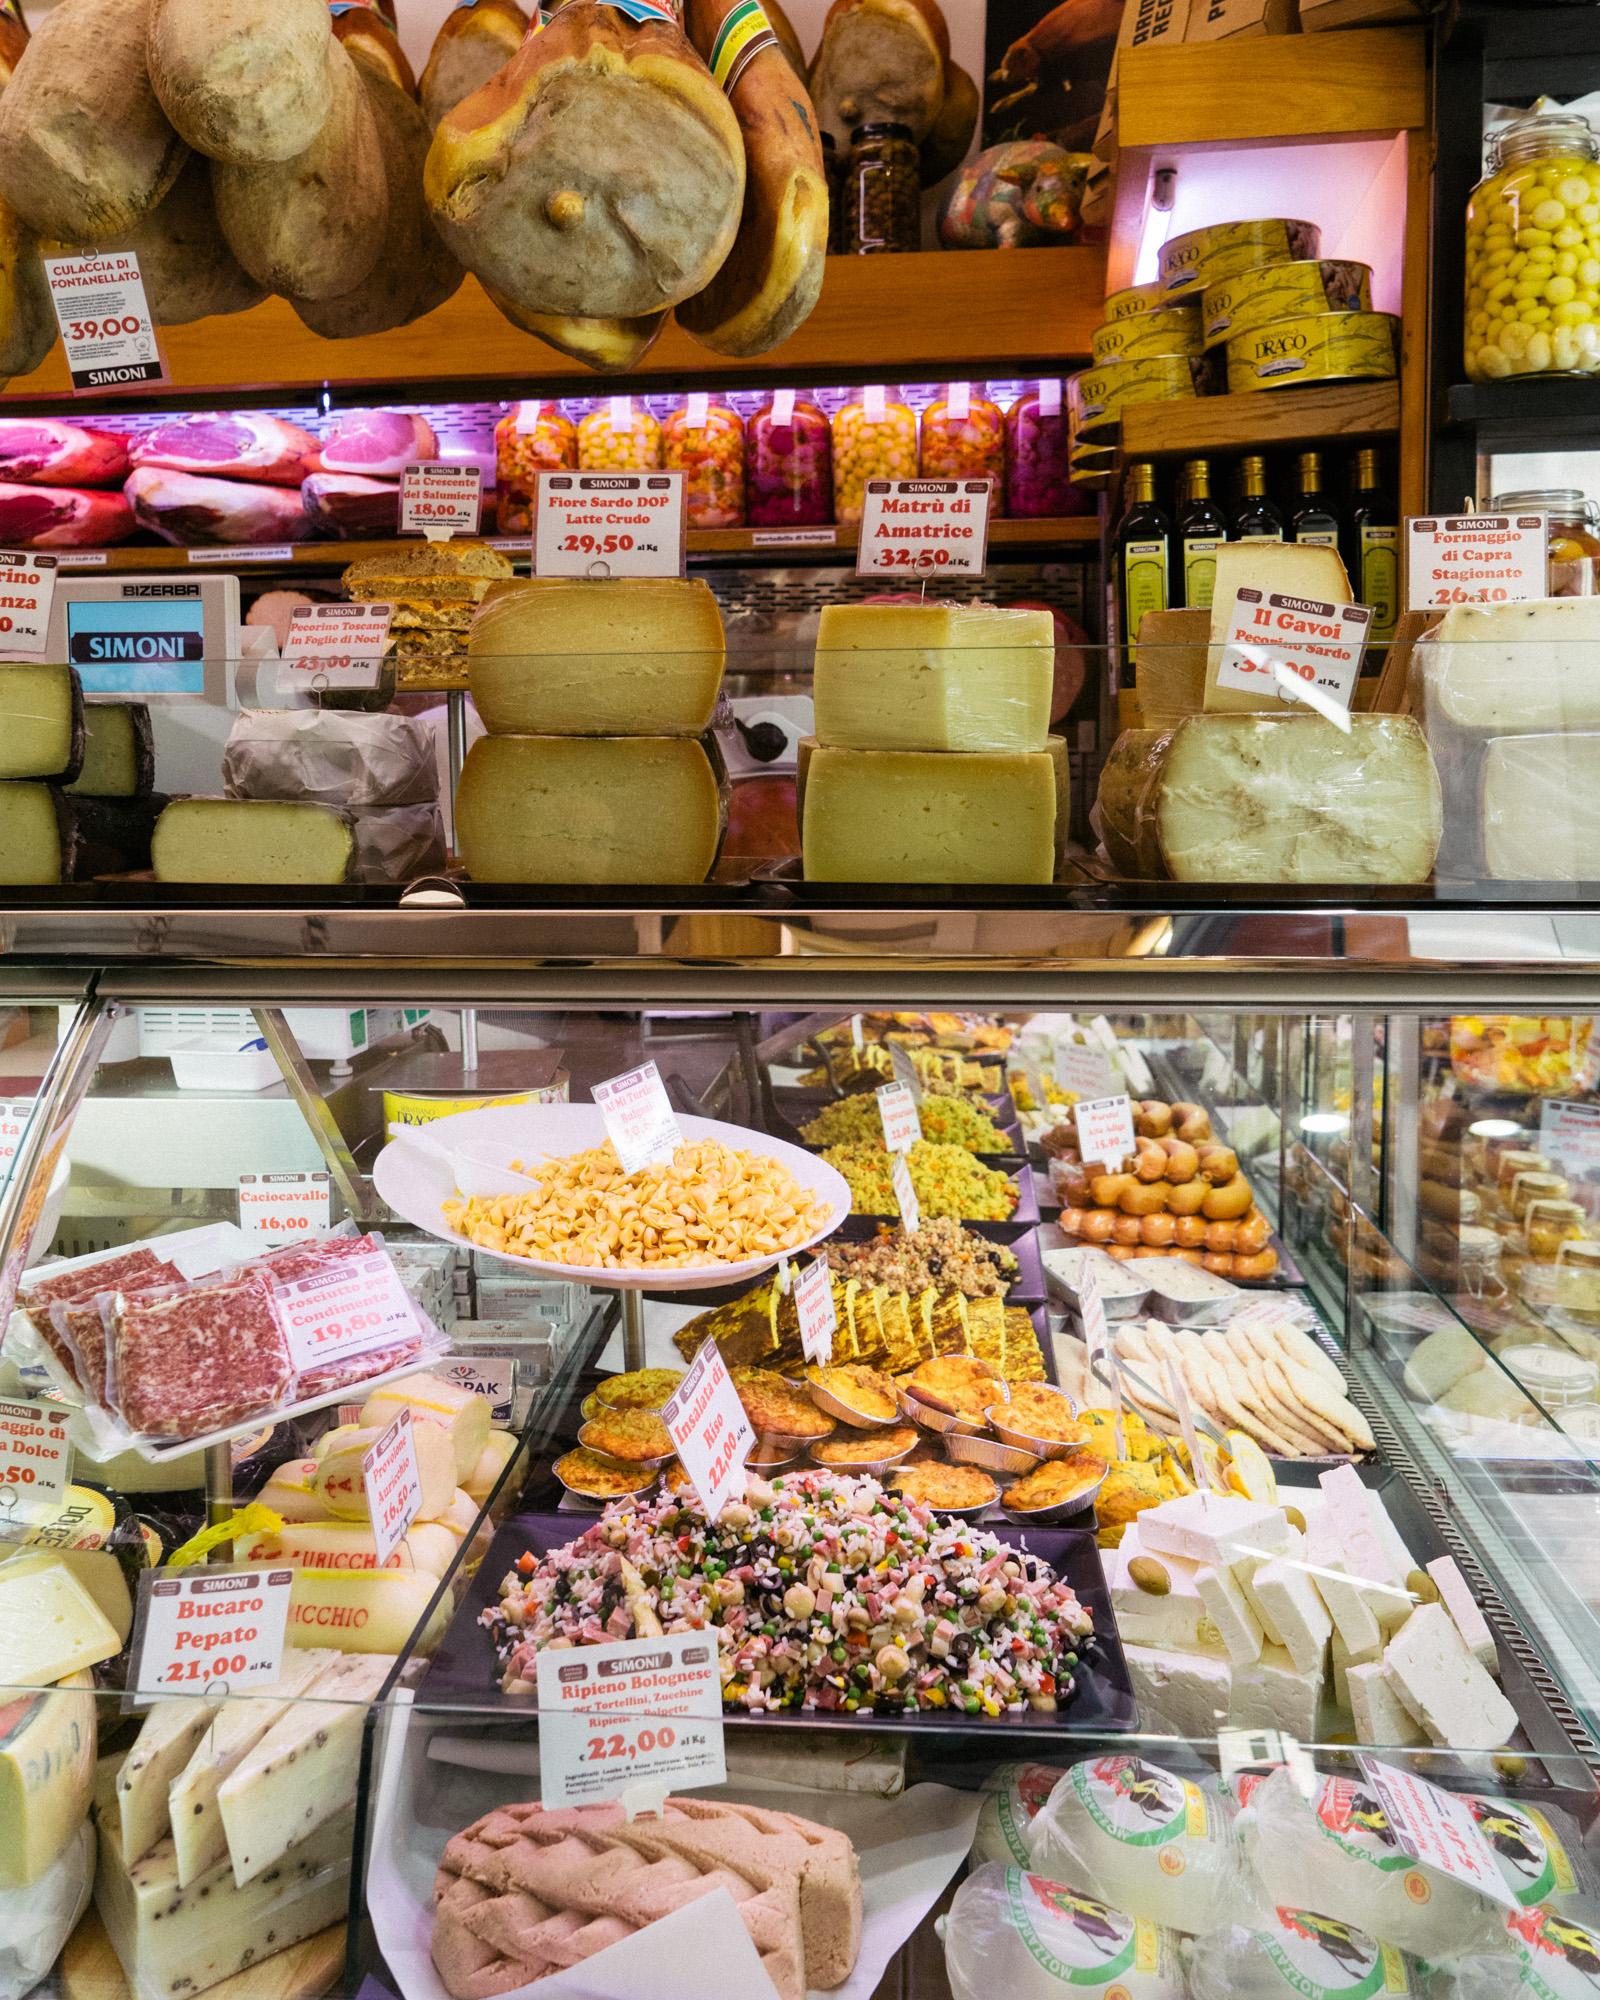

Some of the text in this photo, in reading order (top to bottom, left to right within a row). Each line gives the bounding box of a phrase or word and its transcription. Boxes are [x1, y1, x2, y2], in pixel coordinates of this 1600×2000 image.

[53, 259, 129, 276] CULACCIA DI
[51, 271, 140, 289] FONTANELLATO
[63, 331, 70, 339] €
[69, 315, 141, 343] 39,00
[1255, 334, 1307, 359] DRAGO
[88, 366, 147, 385] SIMONI
[430, 467, 454, 475] SIMONI
[407, 477, 476, 488] La Crescente
[590, 479, 629, 488] SIMONI
[908, 484, 947, 493] SIMONI
[403, 489, 479, 501] del Salumiere
[549, 496, 669, 508] Fiore Sardo DOP
[414, 503, 456, 517] 18,00
[881, 499, 971, 513] Matrù di
[566, 514, 650, 524] Latte Crudo
[1456, 520, 1497, 530] SIMONI
[874, 523, 973, 539] Amatrice
[1433, 530, 1522, 544] Formaggio
[564, 535, 634, 555] 29,50
[646, 544, 658, 552] Kg
[879, 548, 949, 568] 32,50
[957, 558, 970, 567] Kg
[1442, 550, 1512, 562] di Capra
[1432, 567, 1523, 582] Stagionato
[123, 585, 199, 596] BIZERBA
[325, 608, 357, 616] SIMONI
[1281, 597, 1324, 614] SIMONI
[25, 627, 37, 635] Kg
[290, 621, 387, 633] Pecorino Toscano
[1254, 608, 1271, 626] Il
[1276, 612, 1342, 640] Gavoi
[89, 637, 184, 658] SIMONI
[291, 634, 380, 646] in Foglie di Noci
[1305, 643, 1351, 661] Sardo
[361, 661, 370, 669] Kg
[1327, 680, 1340, 689] Kg
[269, 1174, 299, 1183] SIMONI
[240, 1189, 329, 1203] Caciocavallo
[259, 1217, 309, 1231] 16,00
[308, 1271, 348, 1289] SIMONI
[287, 1284, 361, 1311] rosciutto
[290, 1293, 390, 1327] Condimento
[312, 1312, 382, 1343] 19,80
[683, 1366, 704, 1396] SIMONI
[0, 1405, 32, 1417] IMONI
[674, 1362, 725, 1446] Insalata di
[50, 1427, 65, 1440] di
[703, 1412, 724, 1450] Riso
[13, 1440, 59, 1459] Dolce
[372, 1436, 407, 1484] Provolone
[708, 1432, 737, 1490] 22,00
[45, 1481, 56, 1489] Kg
[383, 1483, 409, 1529] 16,50
[203, 1577, 248, 1592] SIMONI
[176, 1598, 264, 1620] Bucaro
[295, 1604, 369, 1628] ICCHIO
[174, 1625, 258, 1651] Pepato
[157, 1654, 272, 1683] € 21,00 al Kg
[611, 1655, 660, 1674] SIMONI
[561, 1667, 712, 1700] Ripieno Bolognese
[652, 1686, 704, 1702] Zucchine
[579, 1753, 585, 1761] €
[587, 1727, 675, 1760] 22,00
[681, 1737, 689, 1745] al
[692, 1734, 706, 1745] Kg
